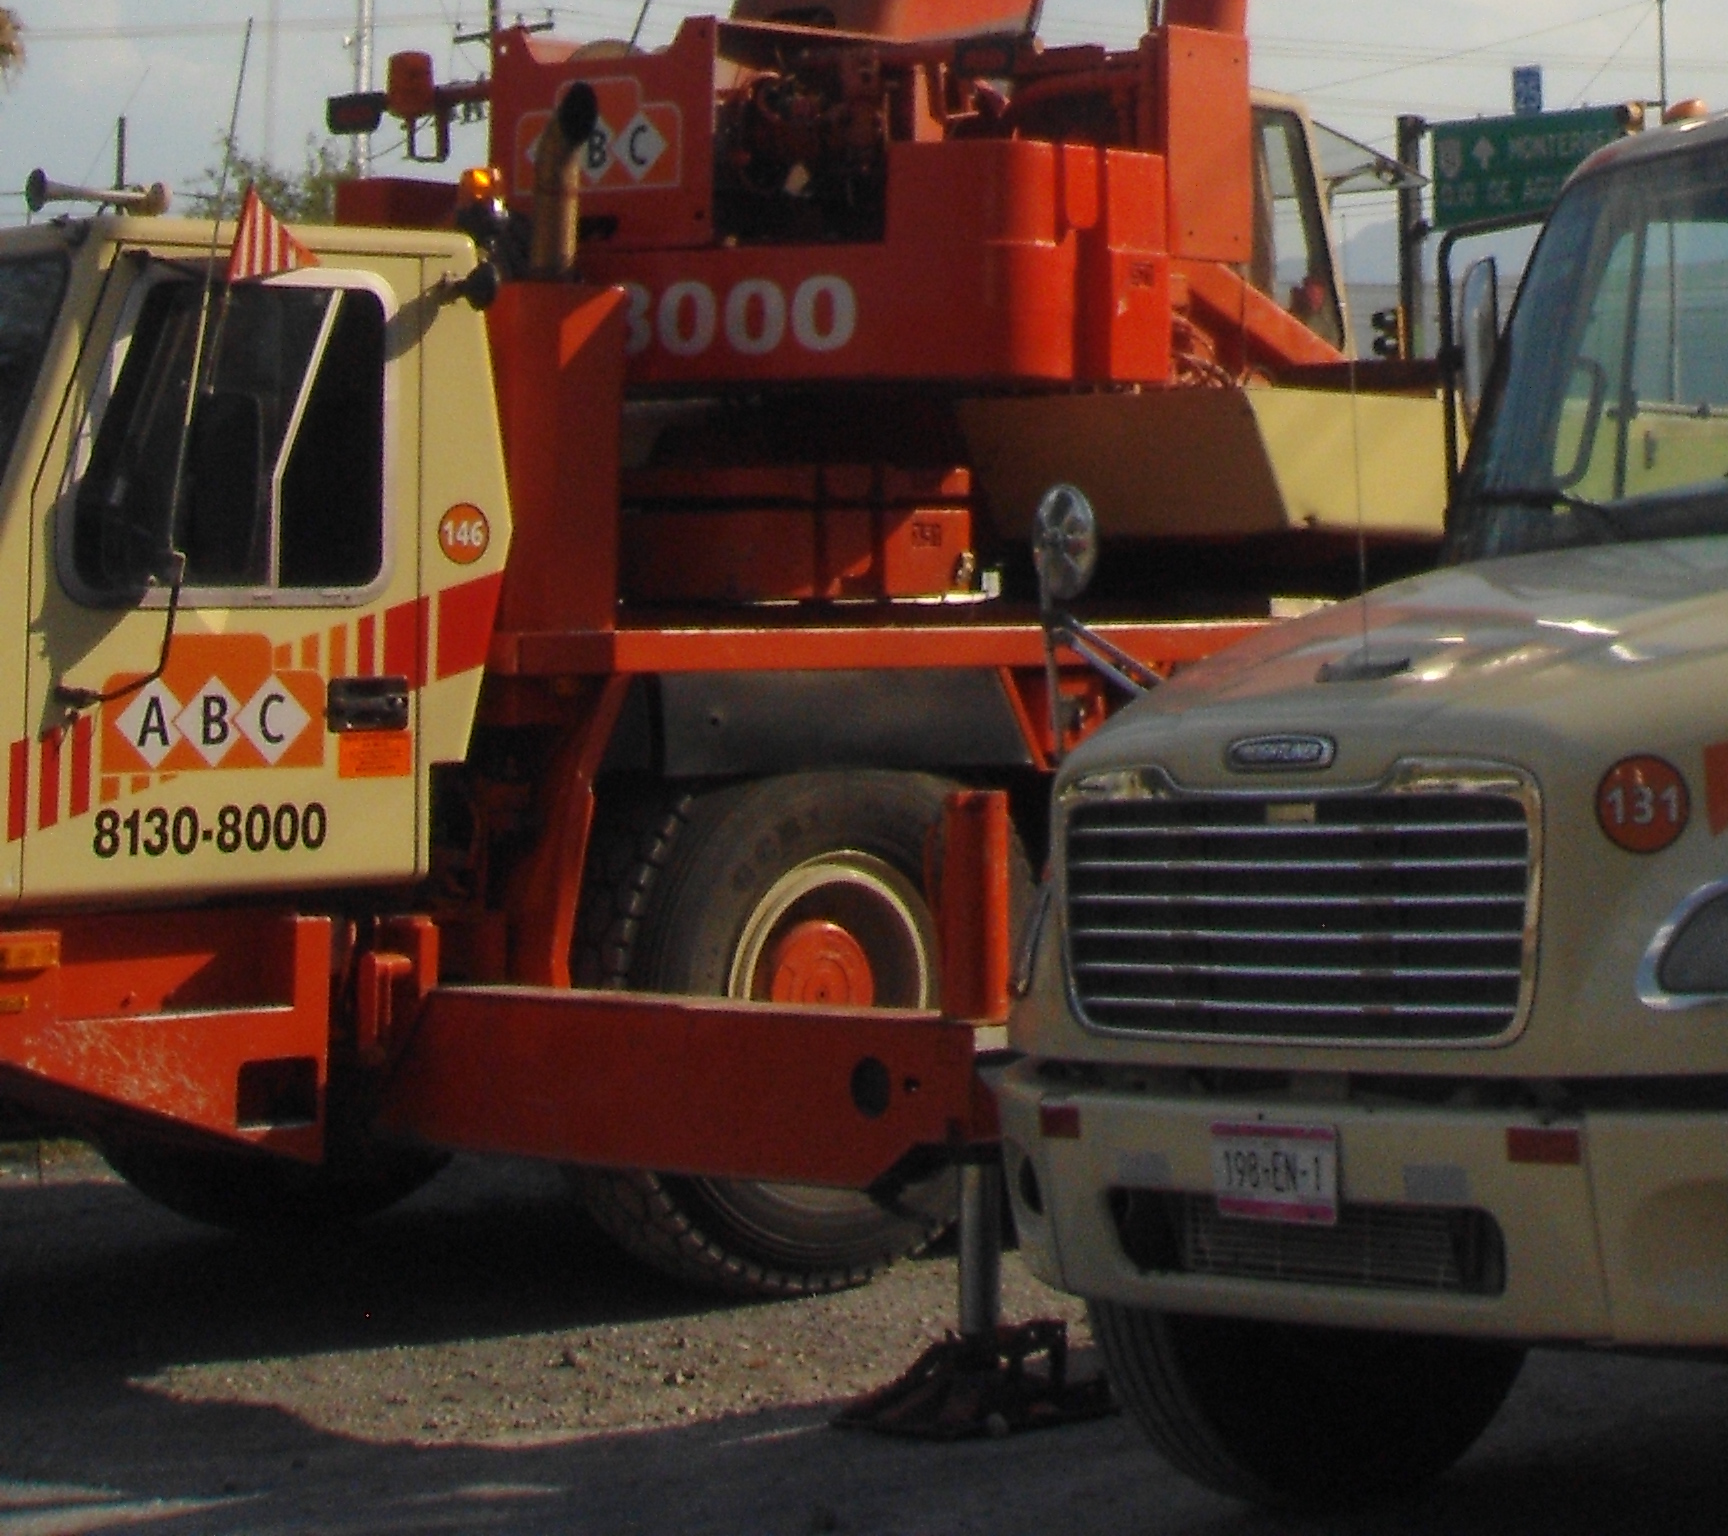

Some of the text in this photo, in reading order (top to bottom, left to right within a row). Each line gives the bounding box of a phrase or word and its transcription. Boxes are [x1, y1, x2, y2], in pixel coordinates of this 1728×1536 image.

[443, 520, 483, 547] 146
[1606, 785, 1677, 824] 131
[93, 802, 327, 858] 8130-8000
